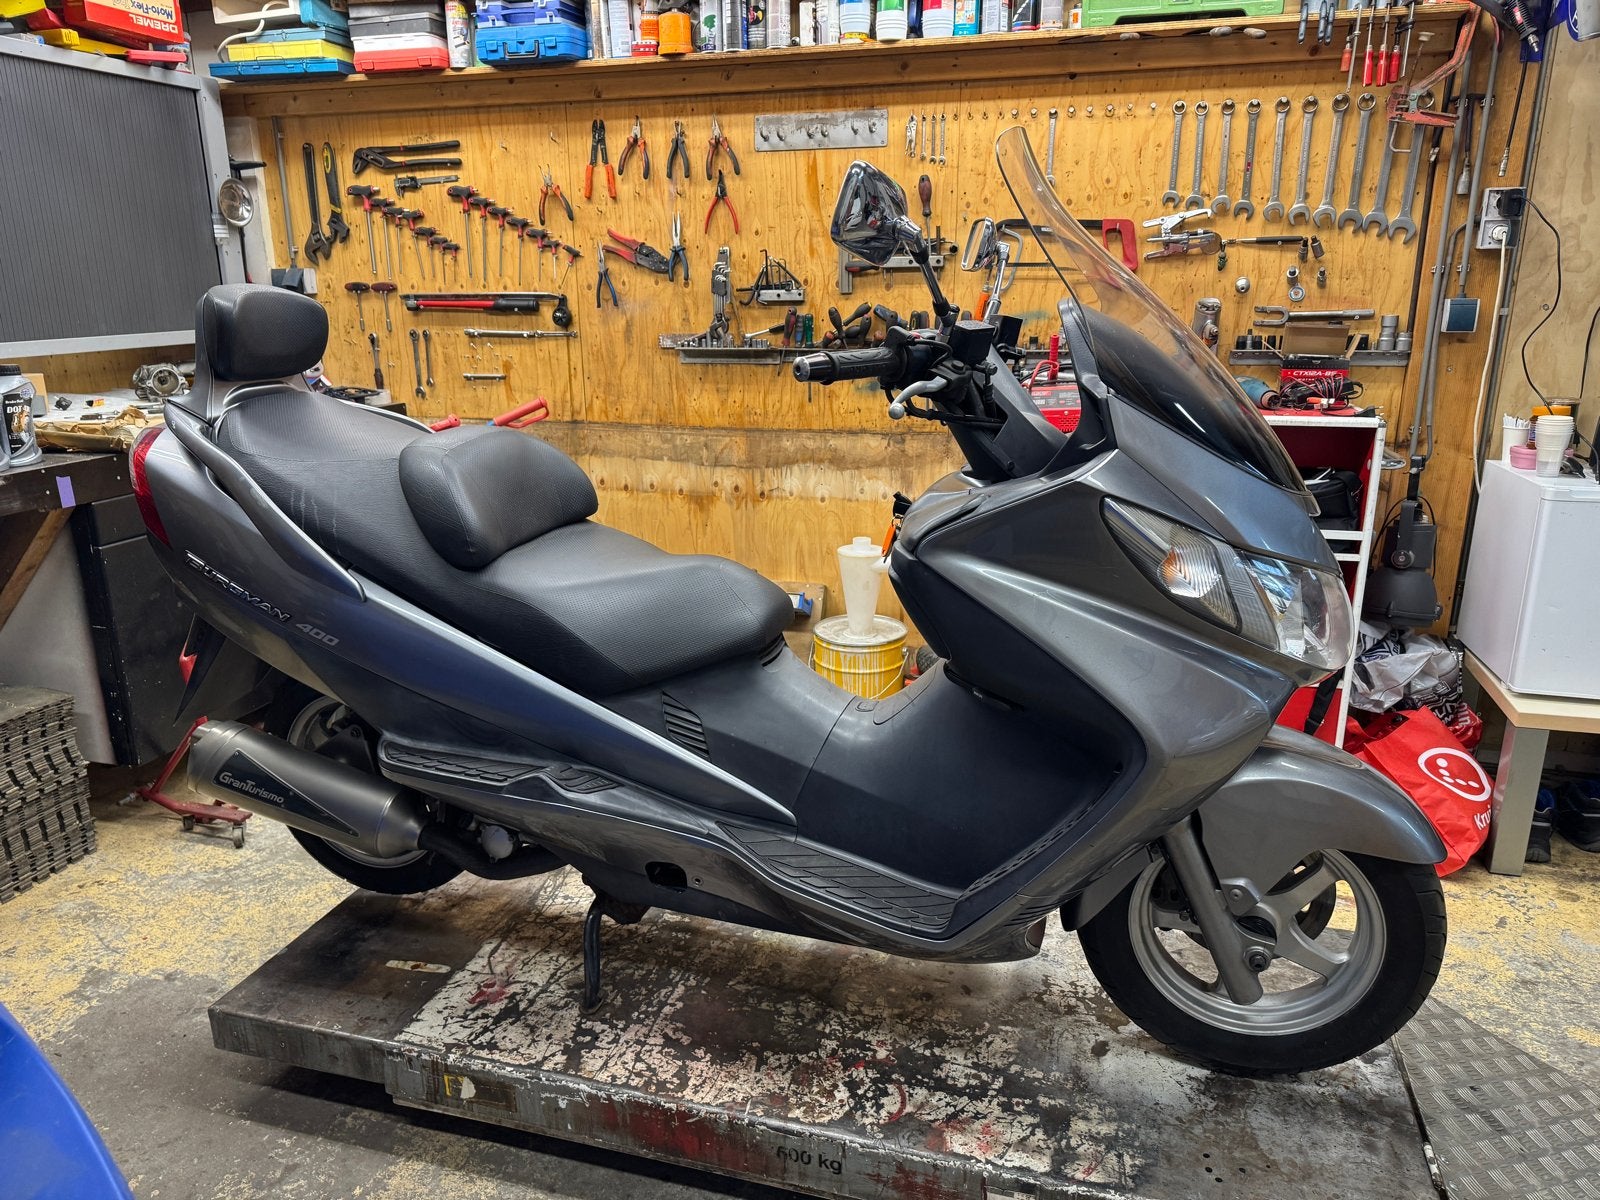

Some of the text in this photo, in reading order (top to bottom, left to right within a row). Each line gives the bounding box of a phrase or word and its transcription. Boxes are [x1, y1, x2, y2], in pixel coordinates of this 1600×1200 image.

[130, 0, 173, 20] Moto-Flex
[129, 13, 179, 34] DREMEL
[6, 405, 22, 414] DOT
[184, 550, 340, 647] BURGMAN 400
[219, 771, 284, 804] GranTurismo
[819, 1153, 842, 1175] kg
